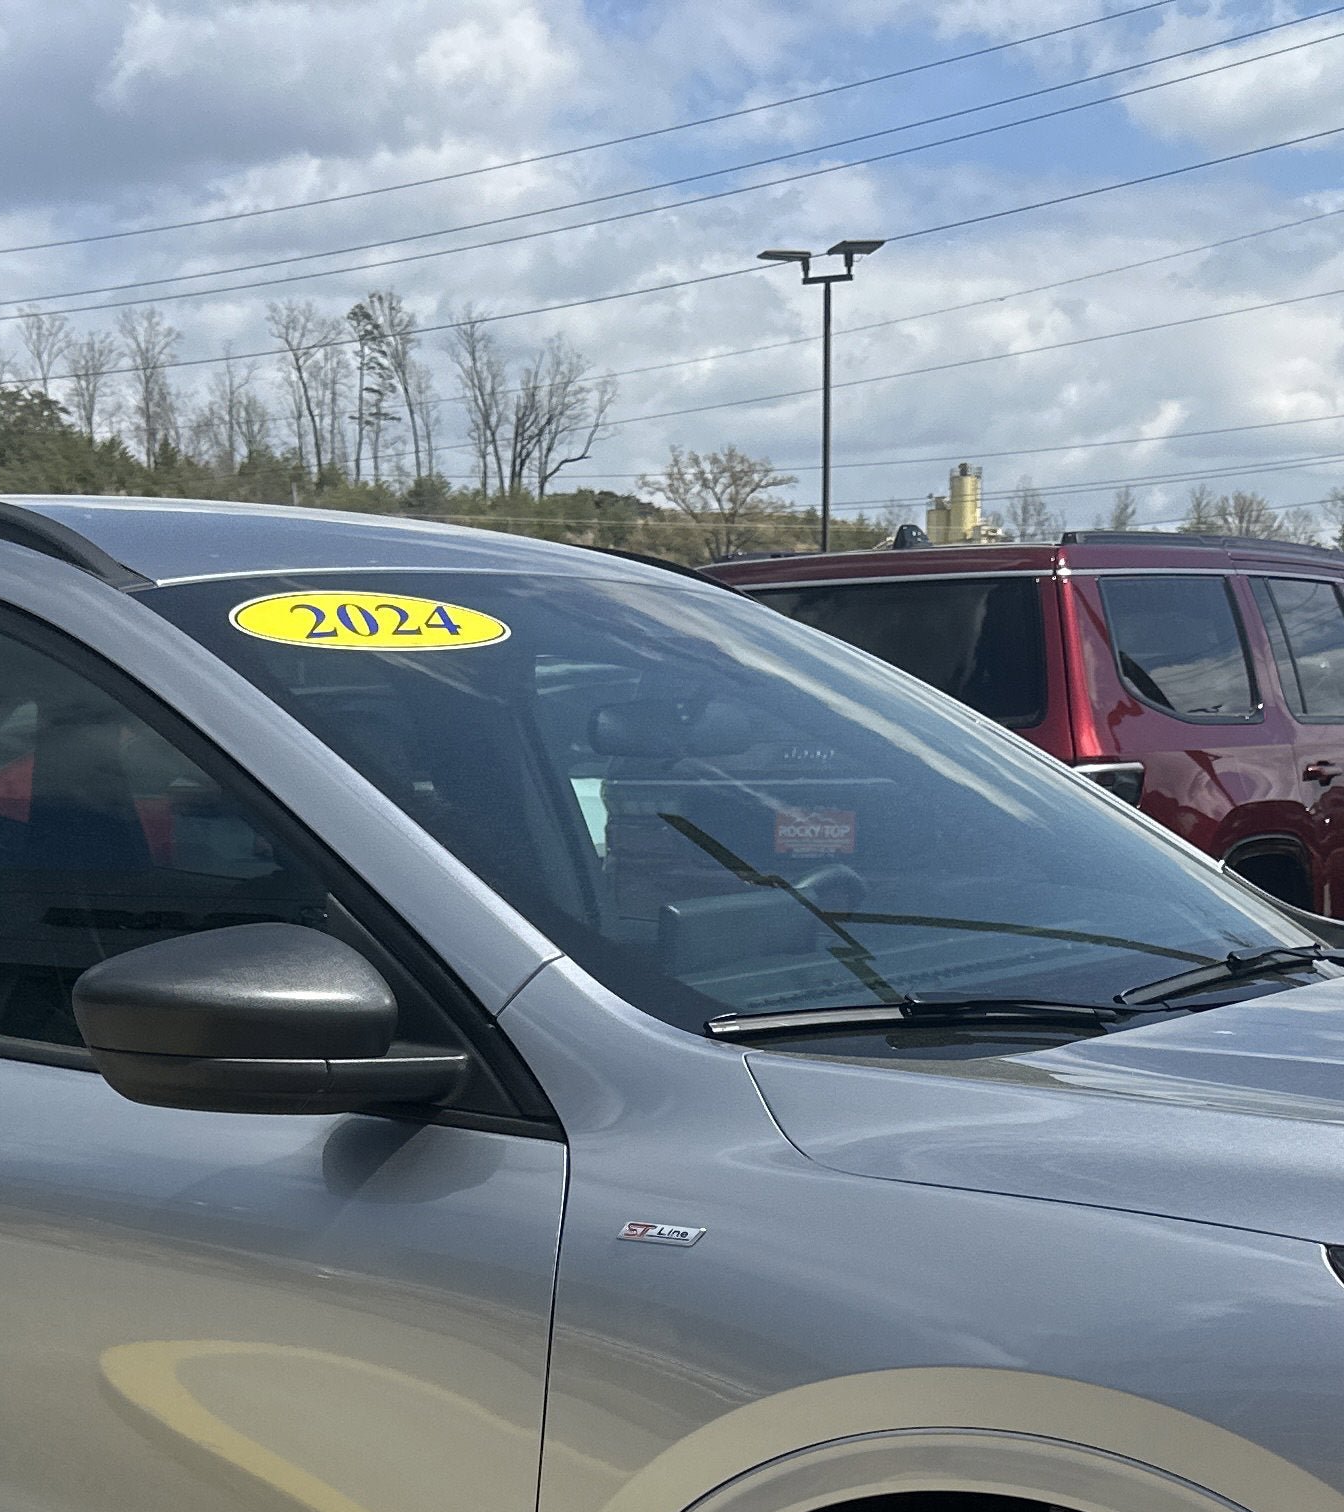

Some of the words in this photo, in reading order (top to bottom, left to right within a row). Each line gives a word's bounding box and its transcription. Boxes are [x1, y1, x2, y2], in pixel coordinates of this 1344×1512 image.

[290, 603, 462, 639] 2024
[778, 825, 822, 838] ROCKY
[823, 825, 851, 838] TOP
[623, 1222, 657, 1239] ST
[657, 1226, 690, 1239] Line
